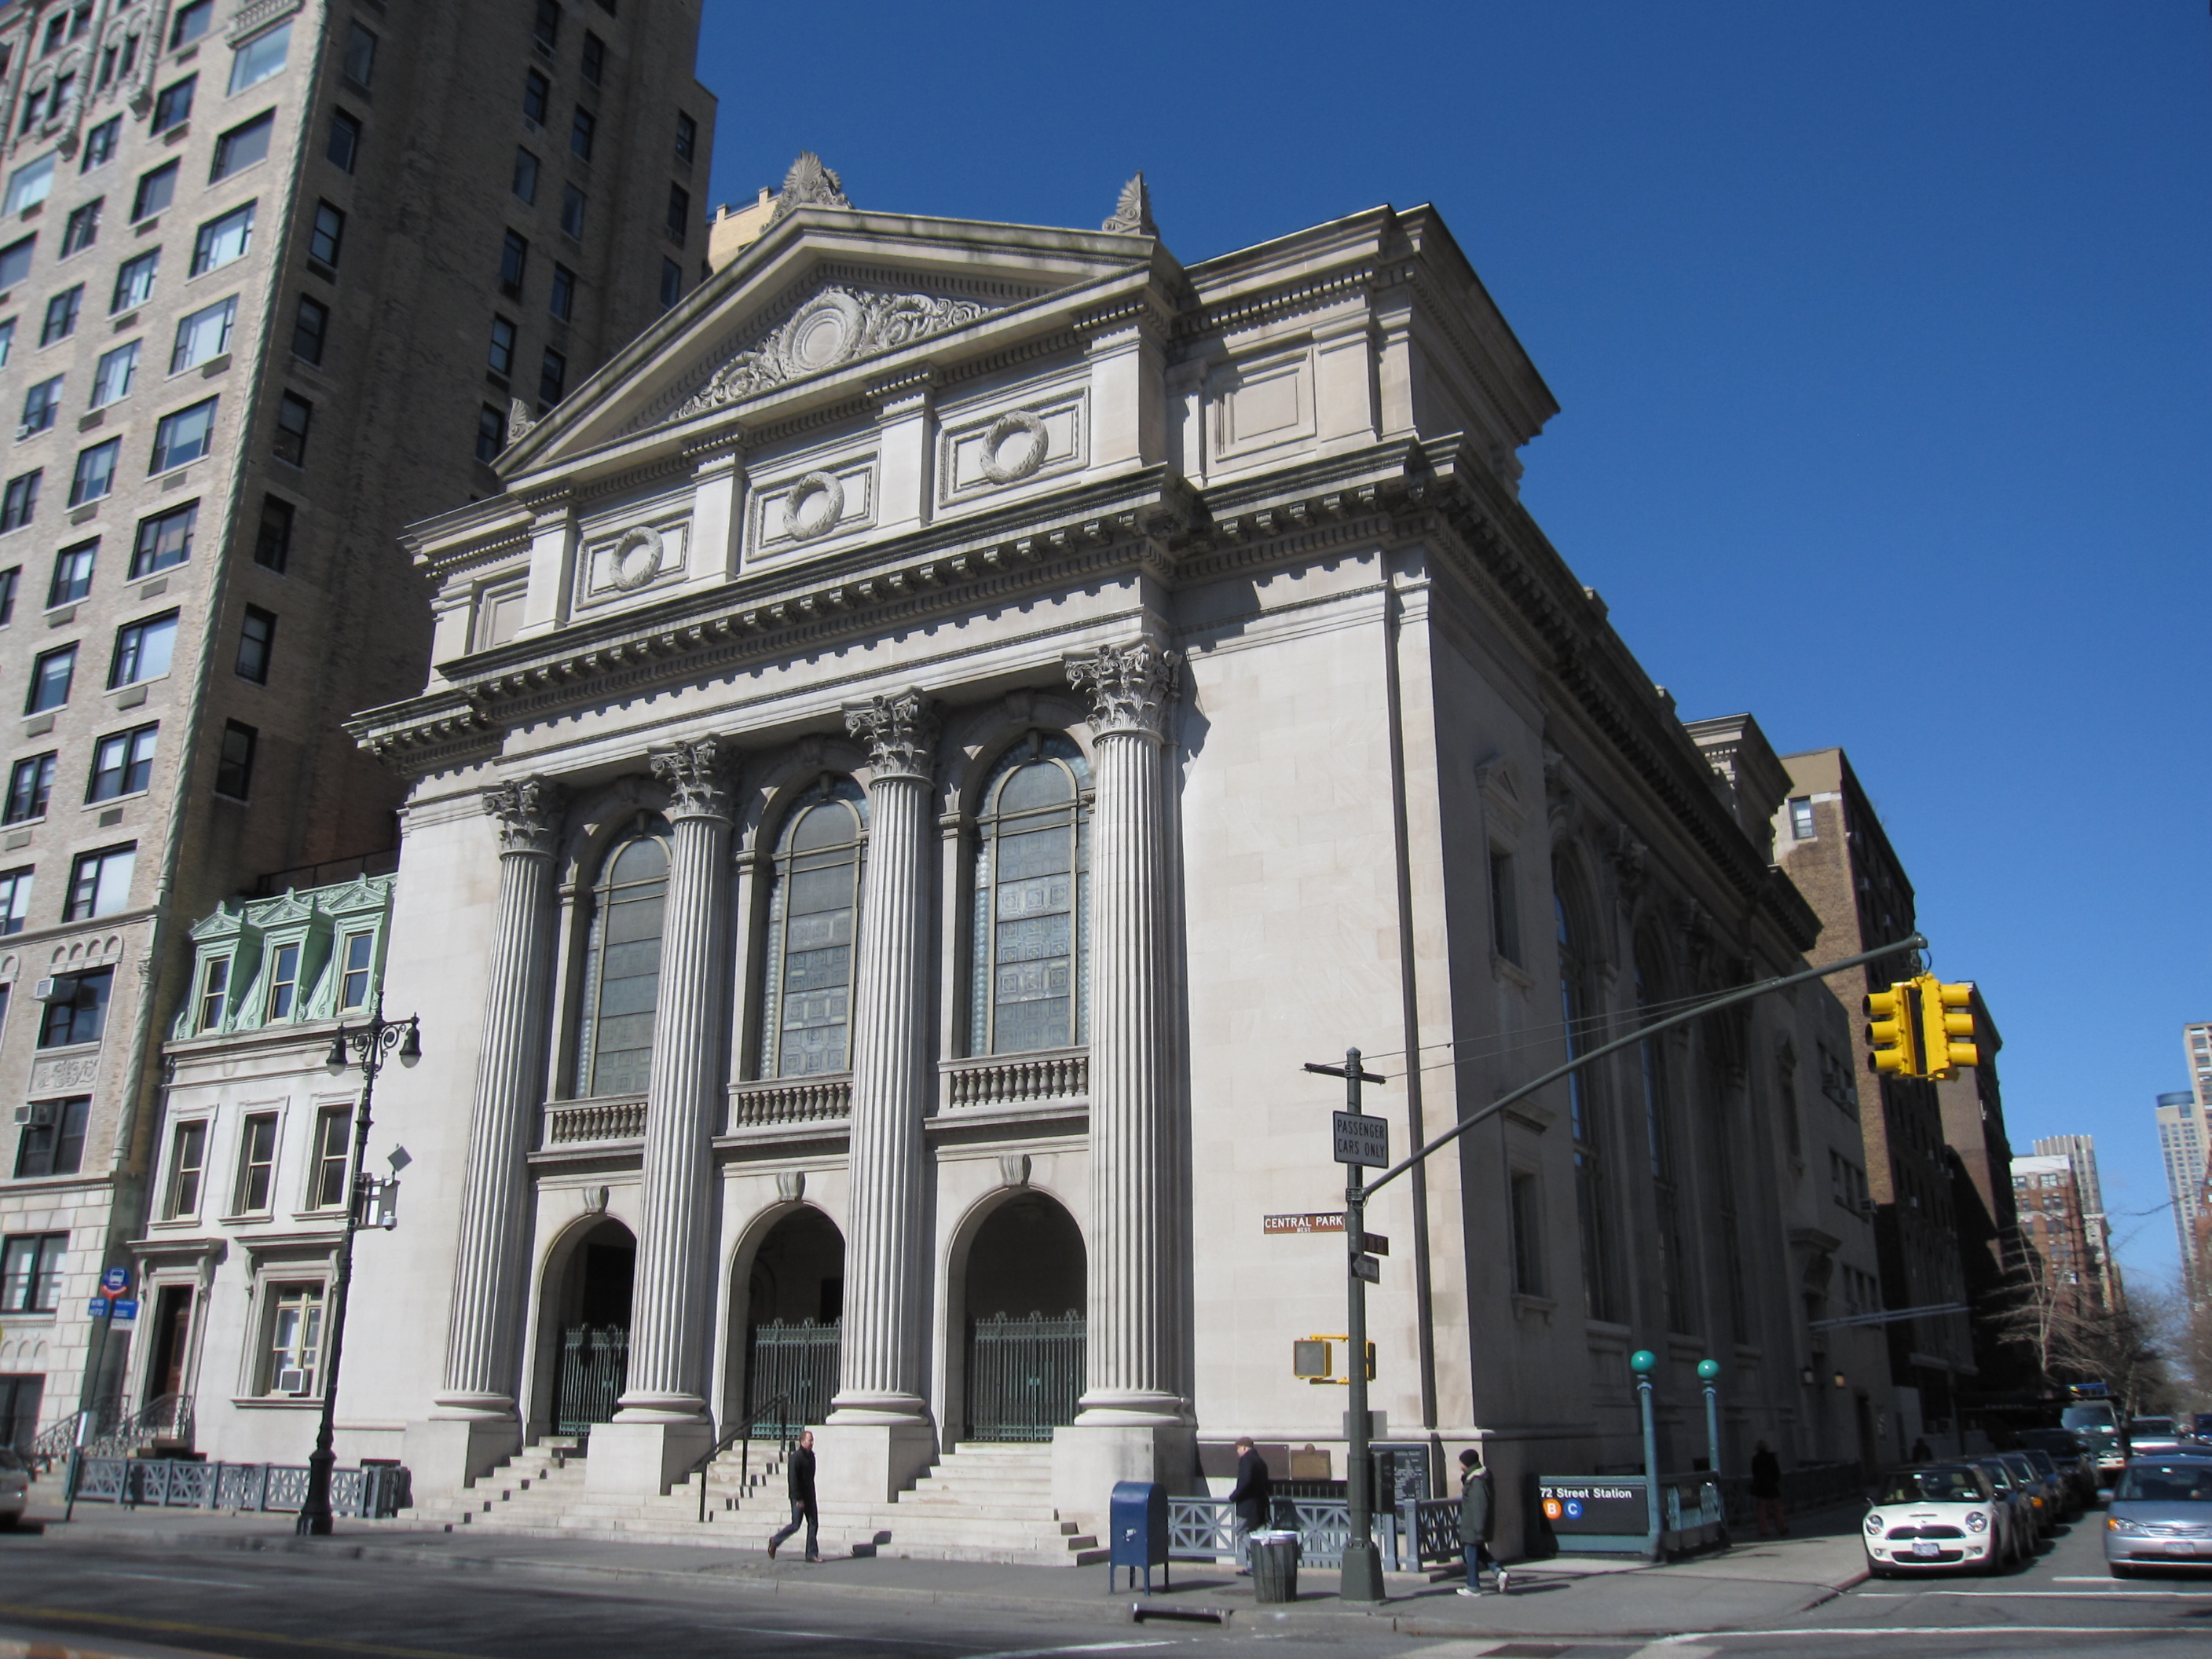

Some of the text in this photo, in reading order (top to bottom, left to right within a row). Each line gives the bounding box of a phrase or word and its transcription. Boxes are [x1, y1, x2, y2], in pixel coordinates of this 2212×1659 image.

[1337, 1119, 1384, 1139] PASSENGER
[1338, 1139, 1385, 1159] CARS ONLY
[1265, 1215, 1342, 1228] CENTRAL PARK
[1540, 1488, 1632, 1498] 72 Street Station
[1547, 1503, 1578, 1514] B C
